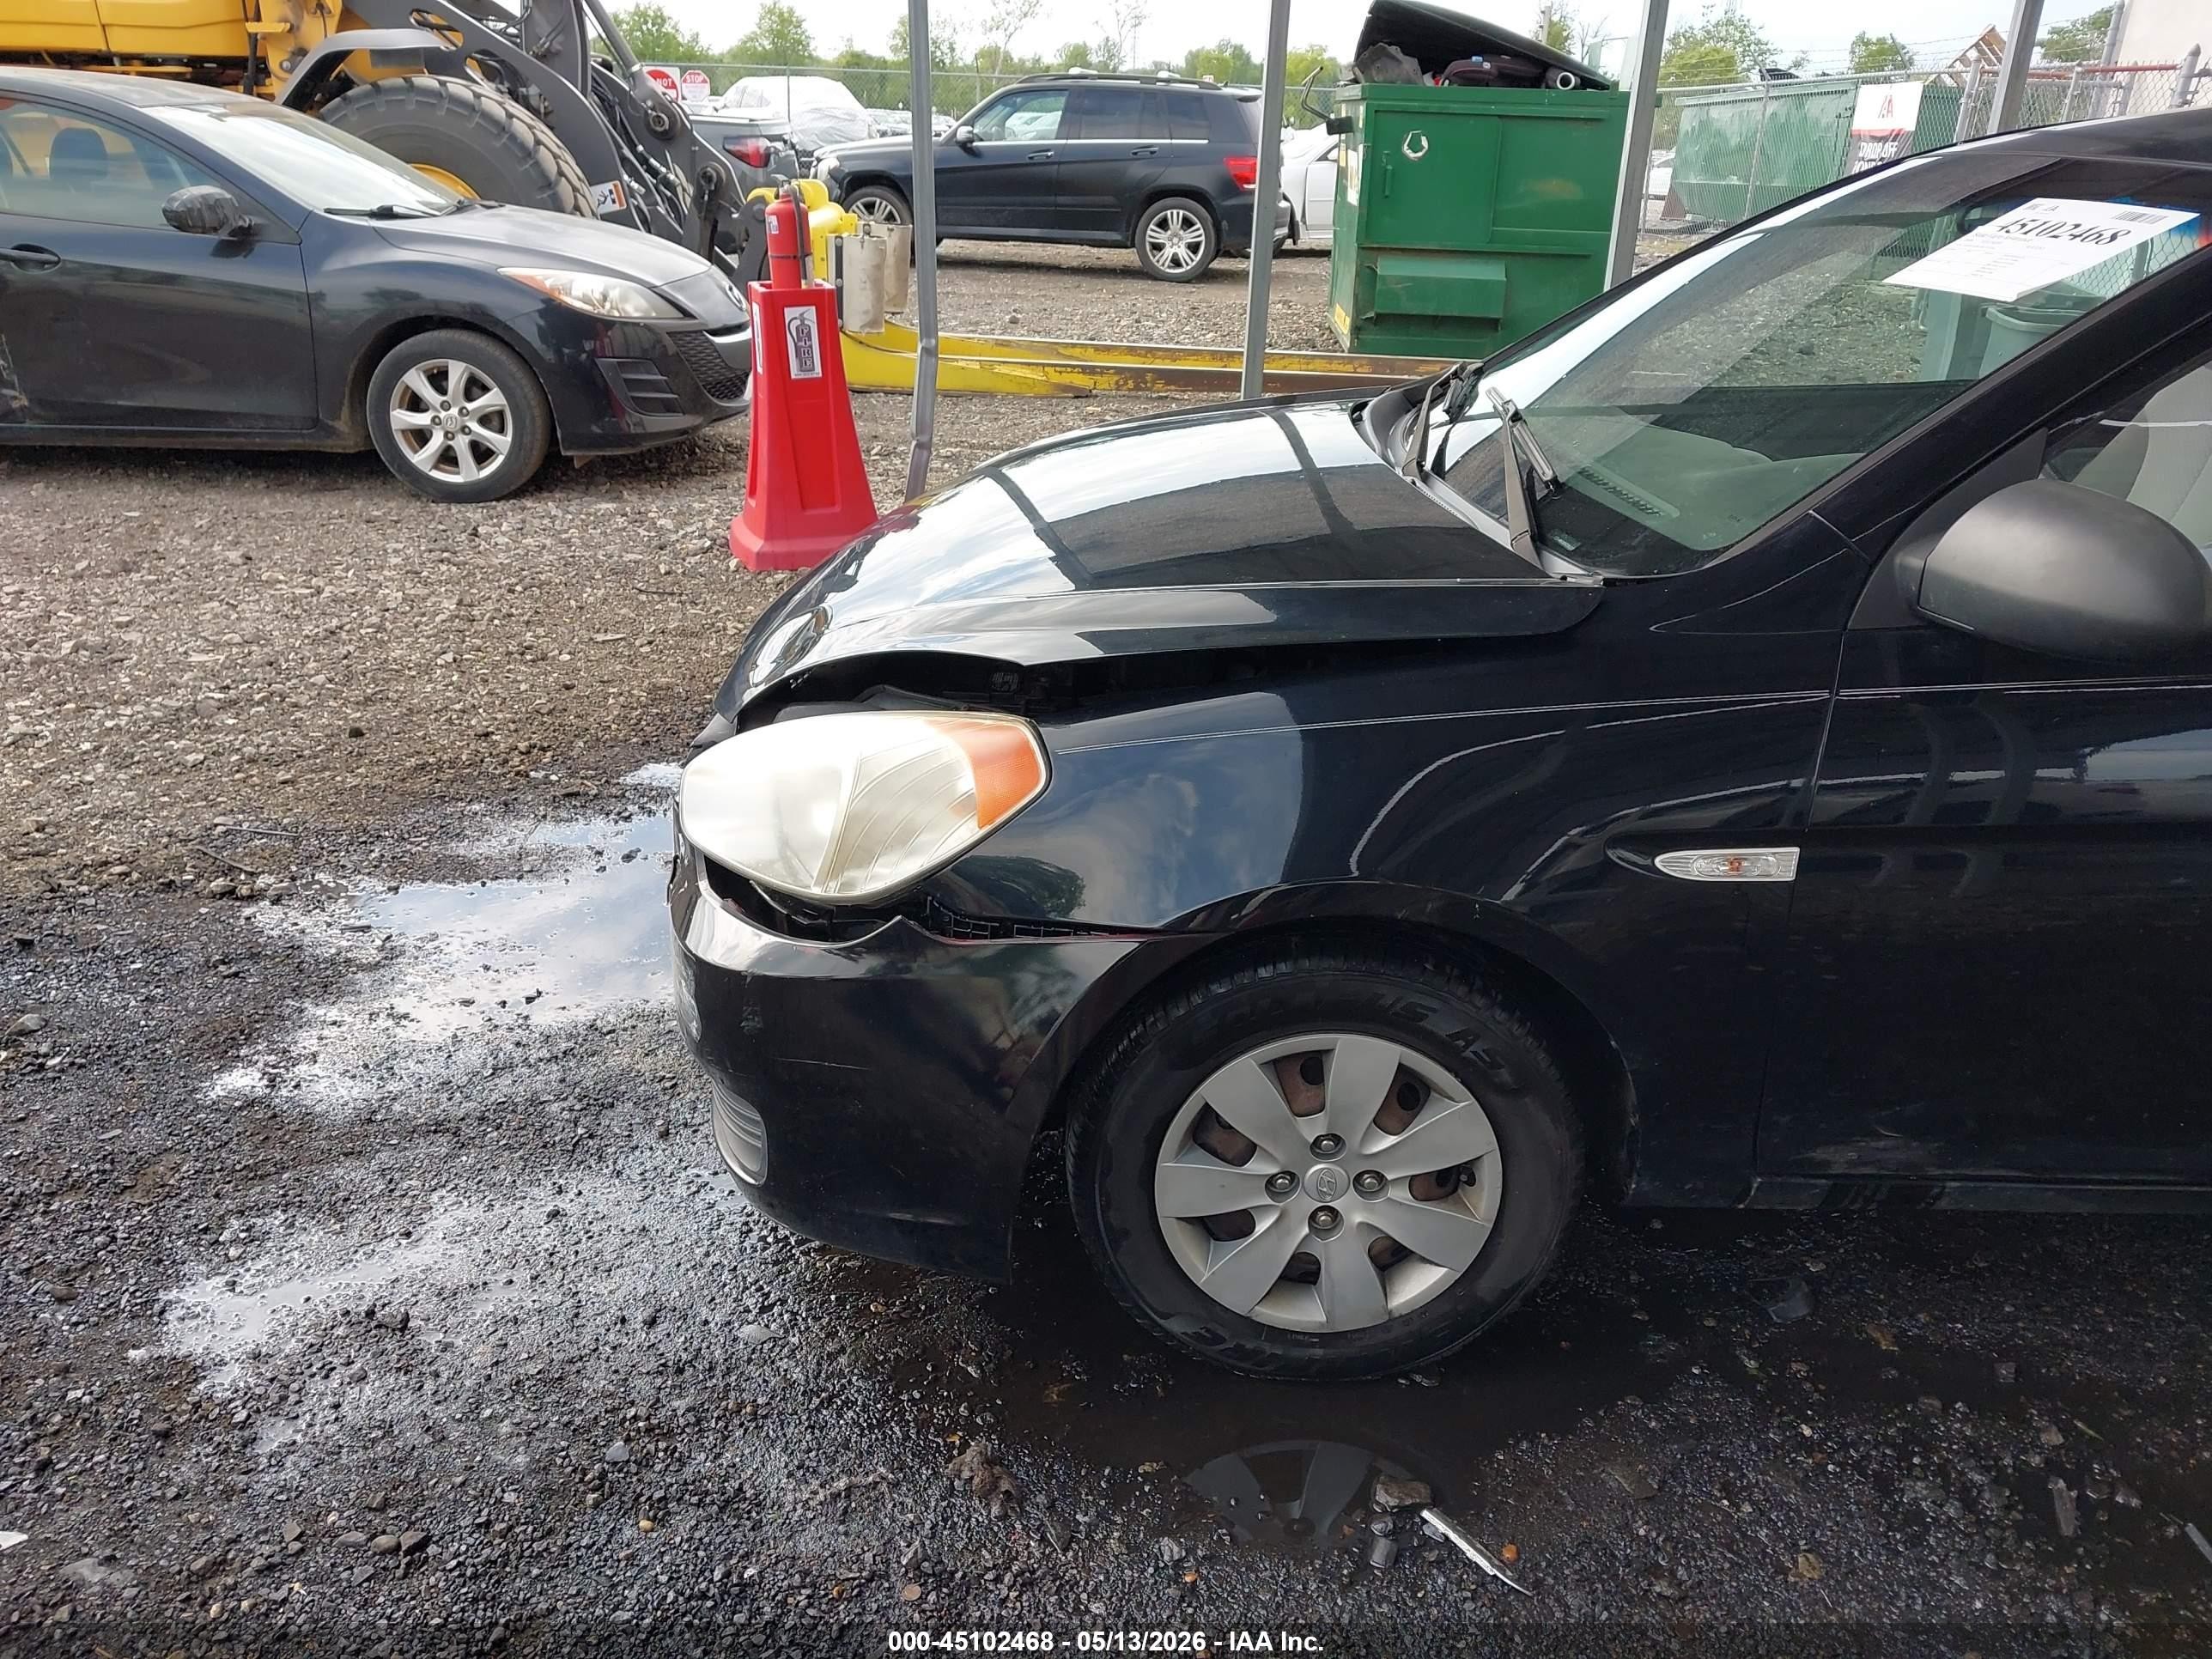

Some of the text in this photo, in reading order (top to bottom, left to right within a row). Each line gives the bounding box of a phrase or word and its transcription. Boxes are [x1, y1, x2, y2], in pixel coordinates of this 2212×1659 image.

[656, 78, 672, 87] NOT
[686, 75, 703, 83] STOP
[1881, 142, 1899, 158] OFF
[1996, 217, 2131, 246] 45102468
[800, 326, 812, 368] FIRE
